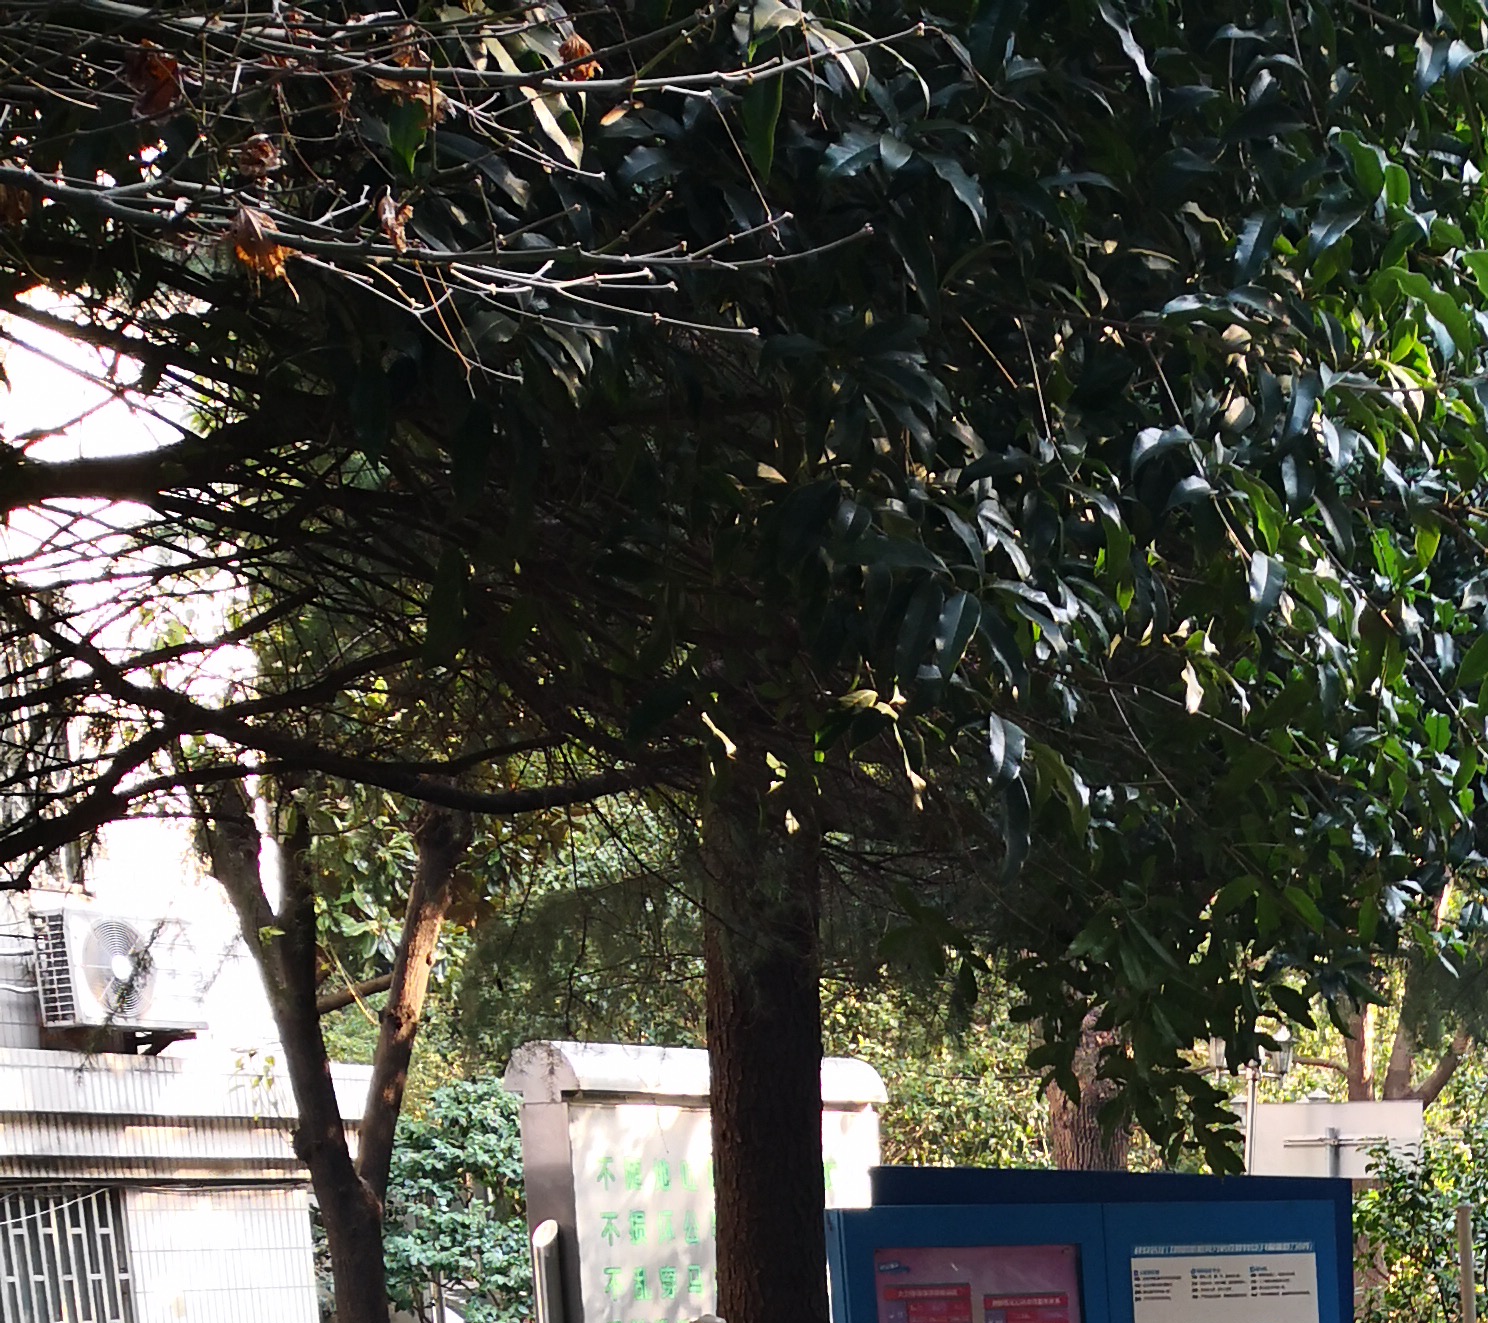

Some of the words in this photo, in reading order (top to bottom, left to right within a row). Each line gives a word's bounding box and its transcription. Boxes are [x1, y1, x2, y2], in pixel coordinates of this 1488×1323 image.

[600, 1209, 716, 1247] 不损坏公
[604, 1264, 718, 1301] 不乱穿马
